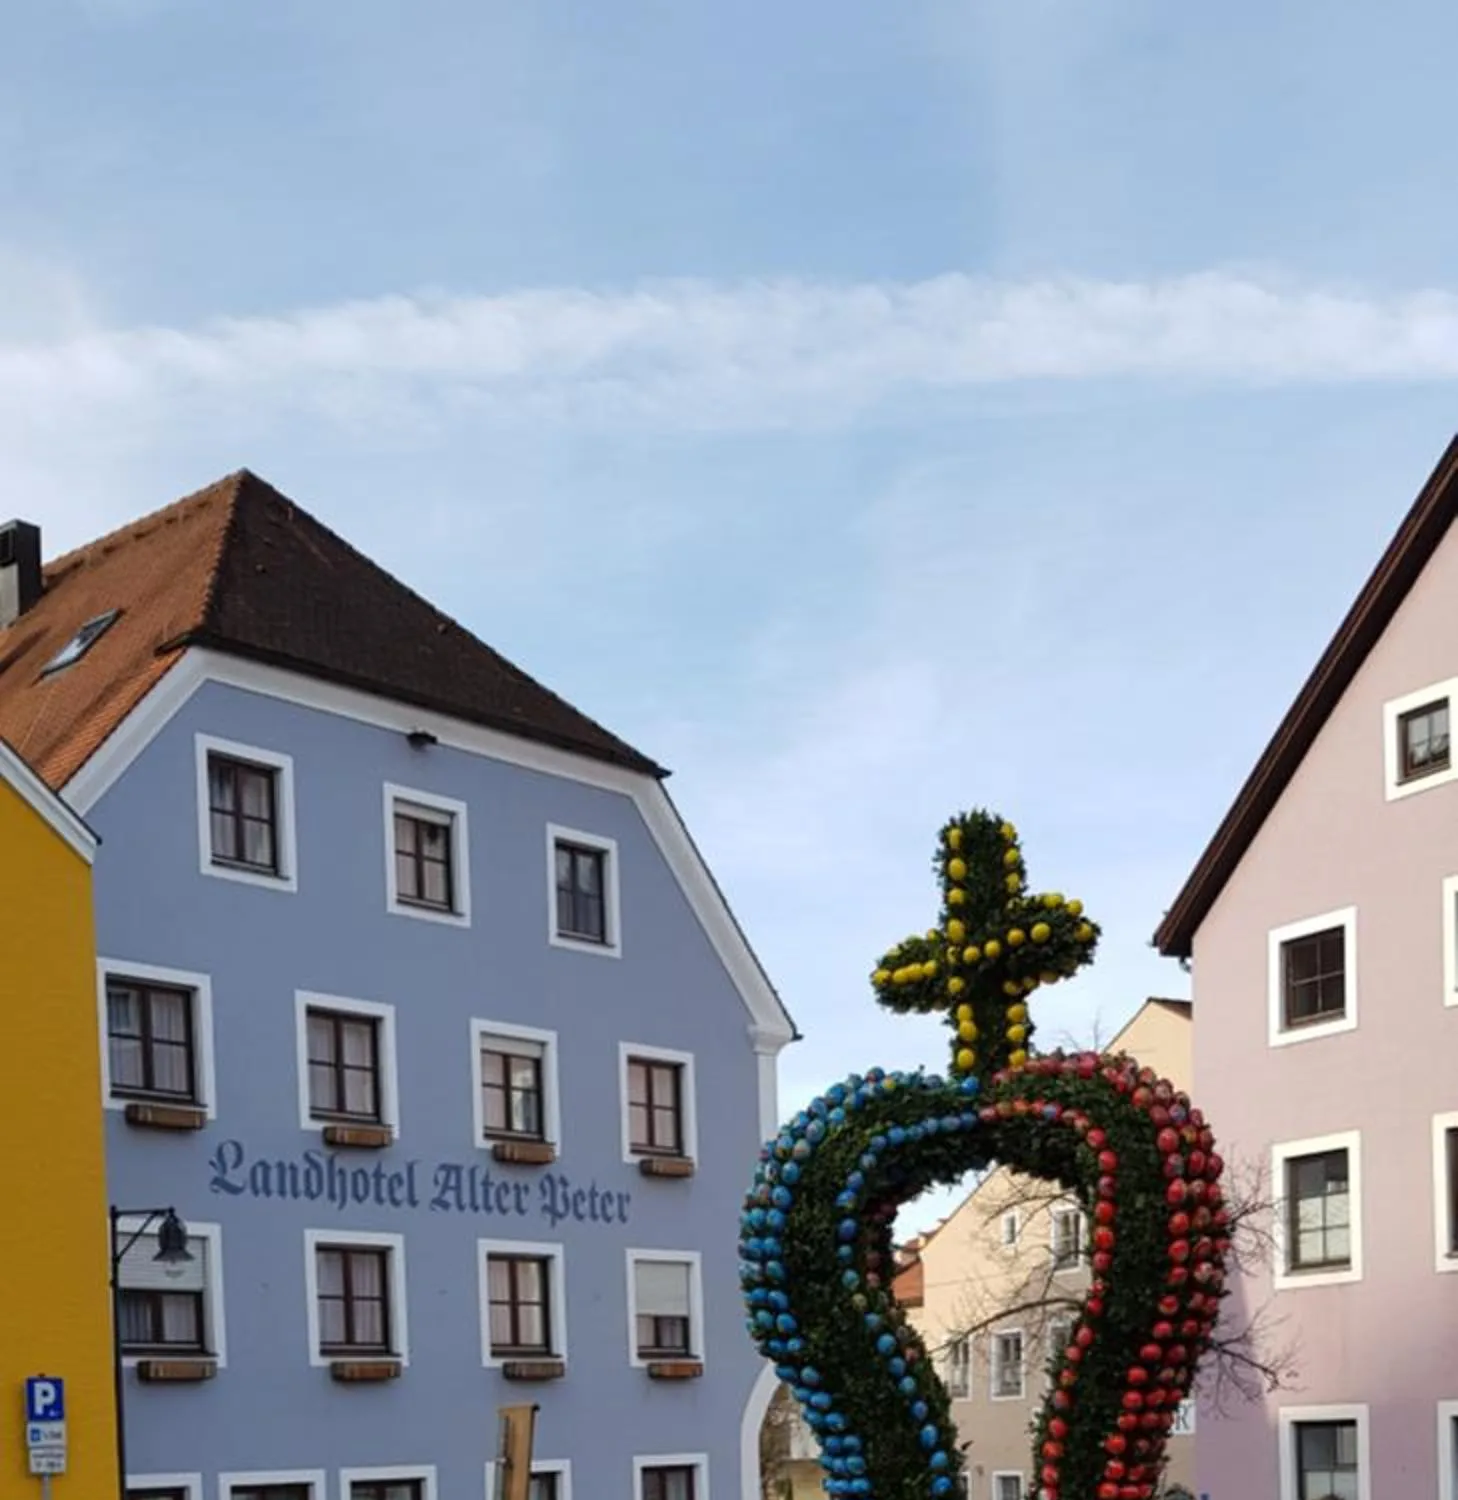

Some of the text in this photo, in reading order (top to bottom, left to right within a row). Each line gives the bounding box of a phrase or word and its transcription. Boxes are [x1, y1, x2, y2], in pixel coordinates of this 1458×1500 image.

[209, 1140, 631, 1228] Landhotel Alter Peter
[34, 1382, 56, 1415] P
